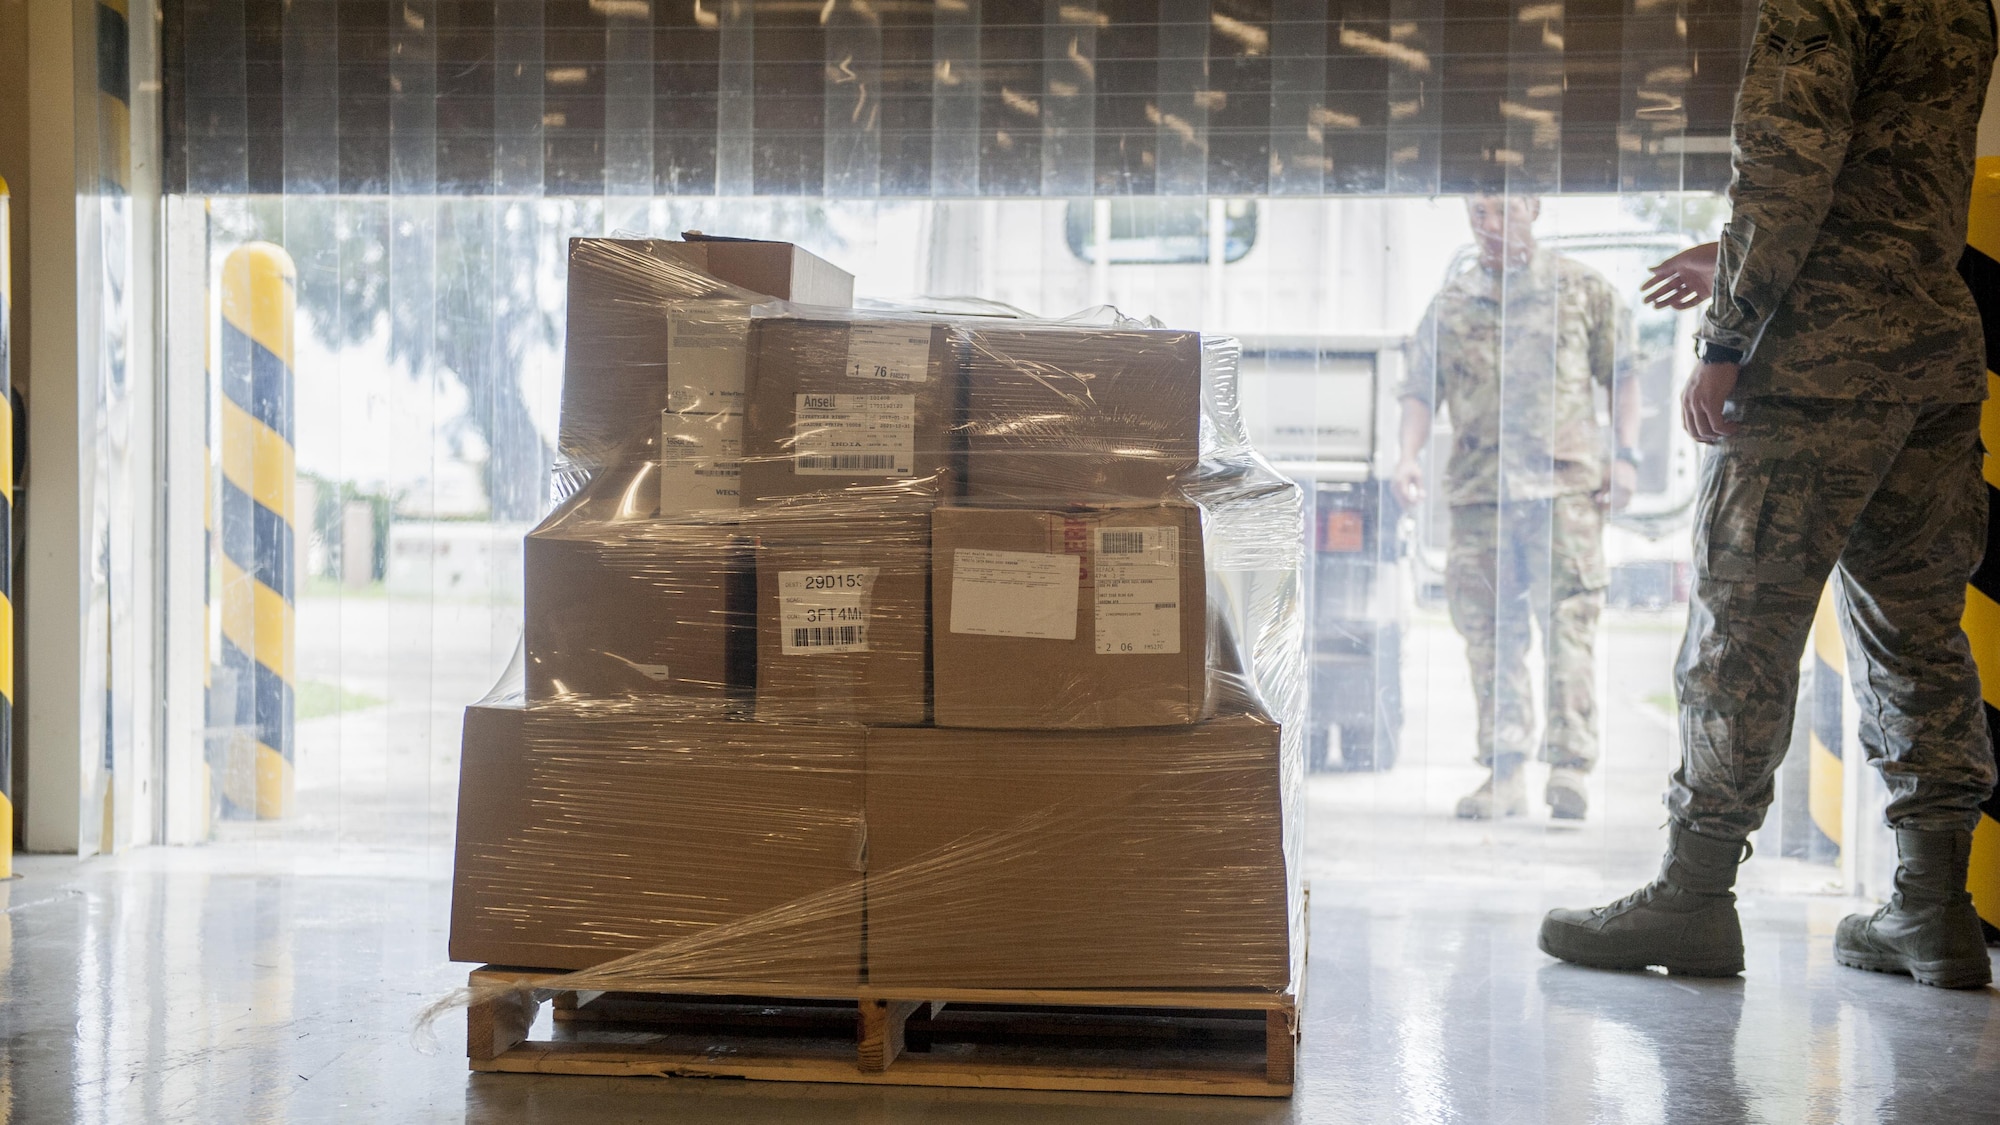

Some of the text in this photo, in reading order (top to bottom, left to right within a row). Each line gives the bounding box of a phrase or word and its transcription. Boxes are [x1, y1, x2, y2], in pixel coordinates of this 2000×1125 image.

[854, 364, 860, 376] 1
[874, 365, 887, 378] 76
[803, 394, 836, 408] Ansell
[1106, 643, 1111, 652] 2
[1120, 642, 1133, 652] 06
